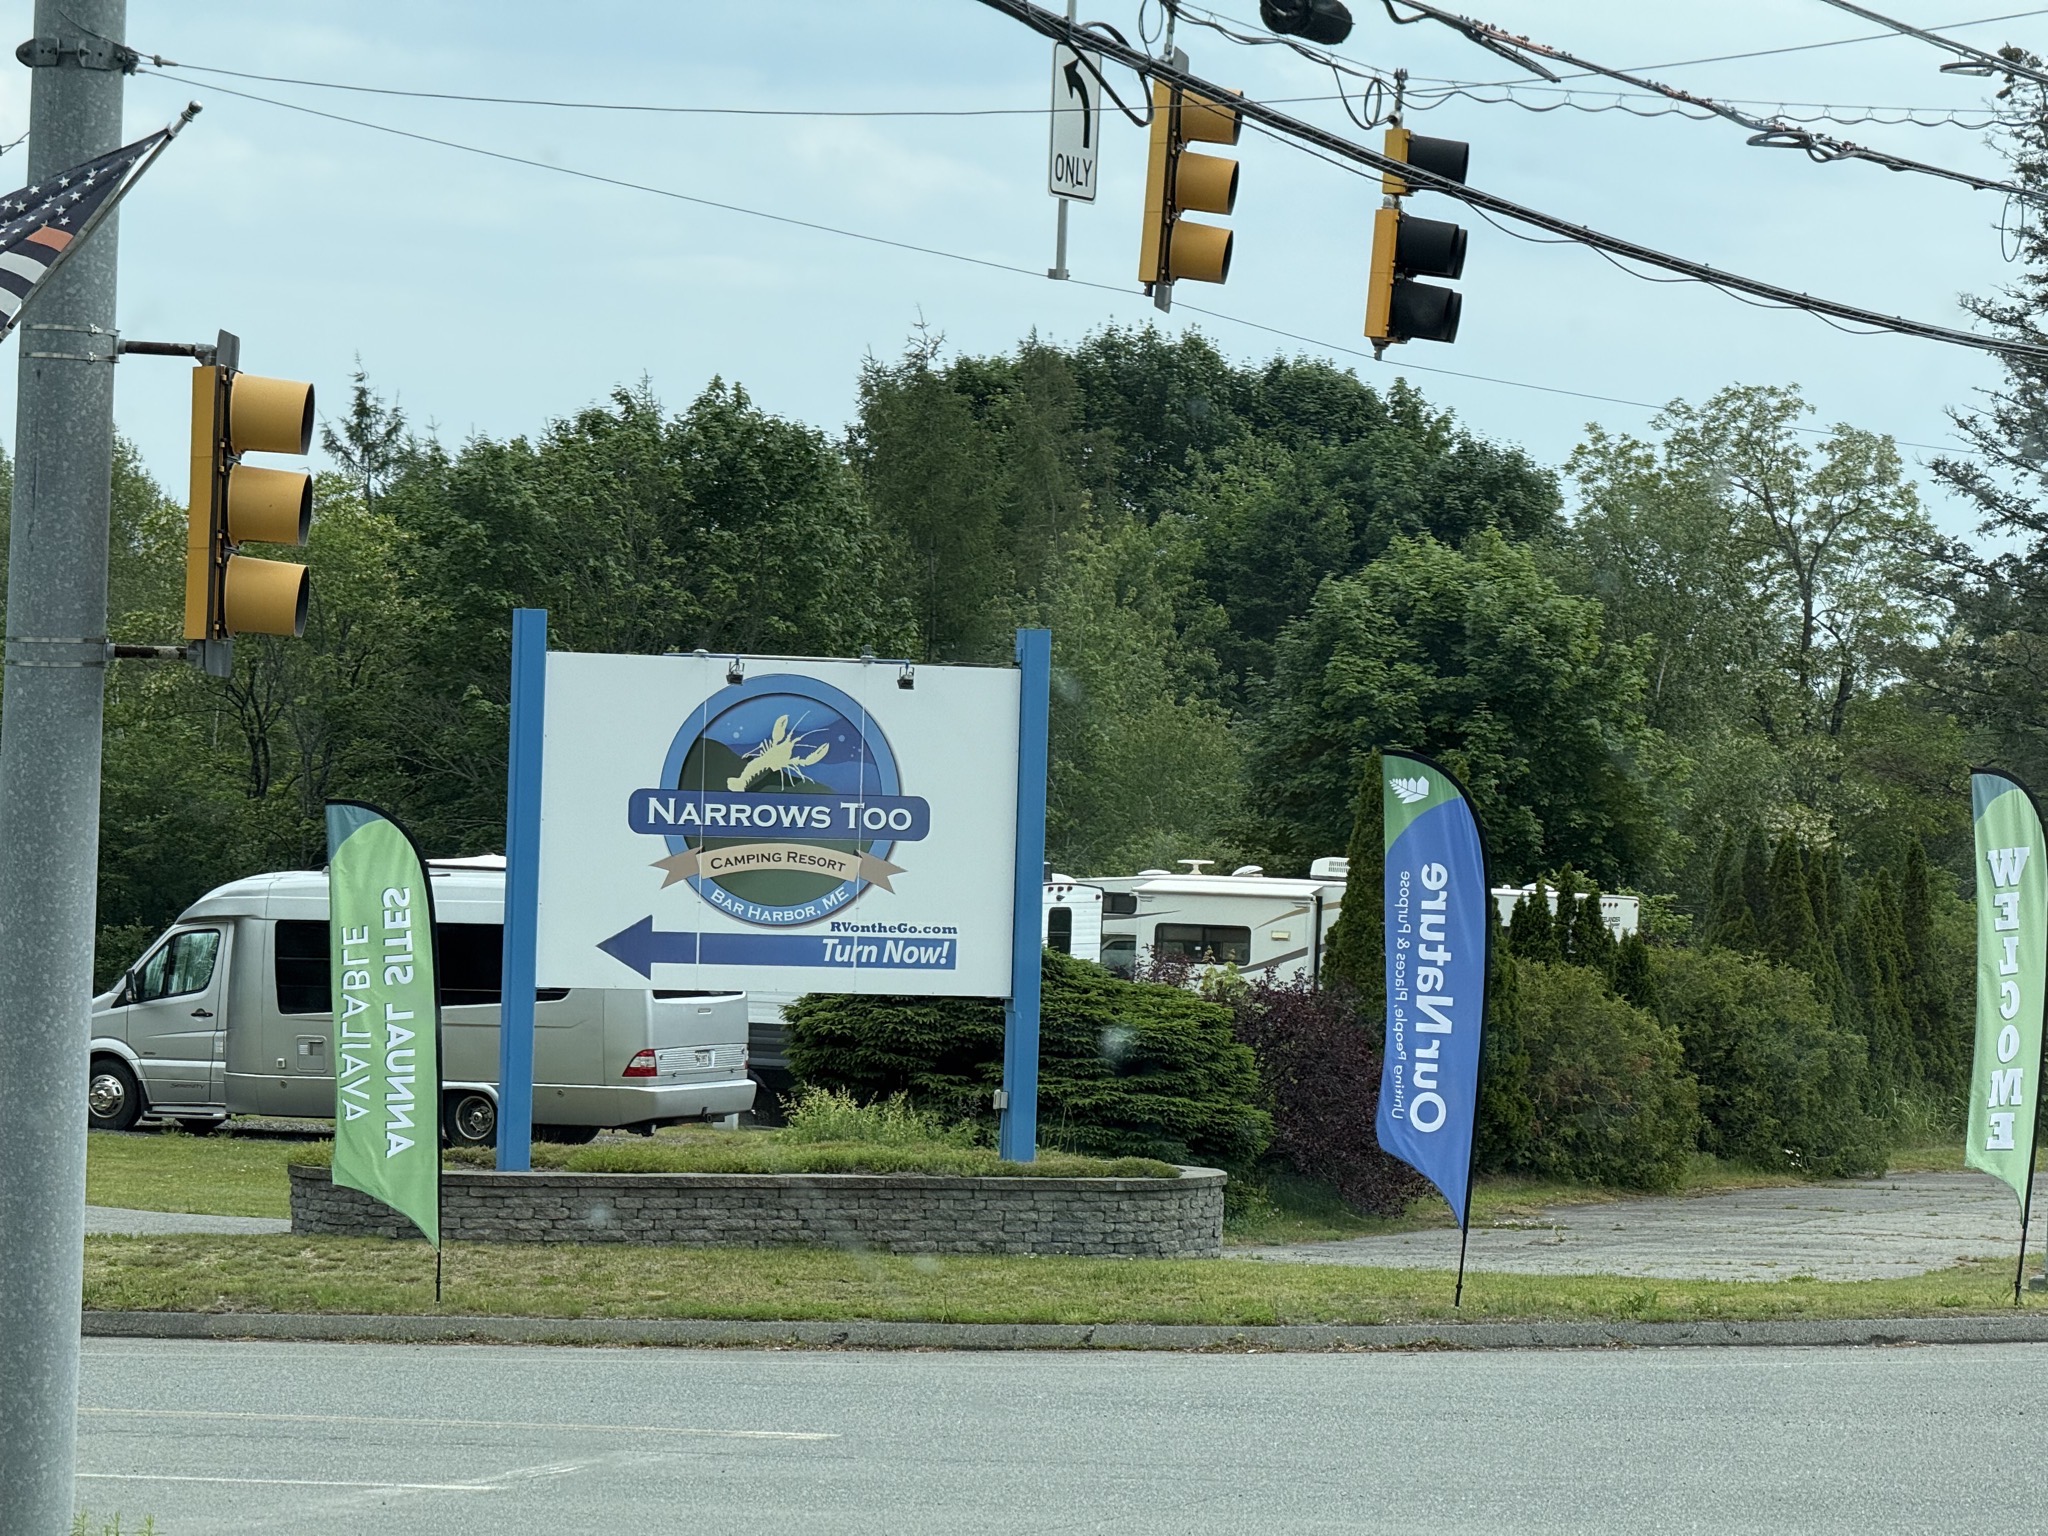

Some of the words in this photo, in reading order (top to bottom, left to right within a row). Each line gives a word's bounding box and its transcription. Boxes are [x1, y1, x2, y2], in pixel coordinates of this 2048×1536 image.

[1055, 153, 1093, 188] ONLY
[647, 797, 832, 830] NARROWS
[840, 801, 913, 831] TOO
[710, 852, 782, 870] CAMPING
[786, 851, 847, 873] RESORT
[710, 888, 744, 916] BAR
[747, 906, 821, 923] HARBOR,
[822, 886, 850, 911] ME
[830, 921, 958, 935] RVontheGo.com
[822, 938, 878, 963] Turn
[882, 939, 950, 965] Now!
